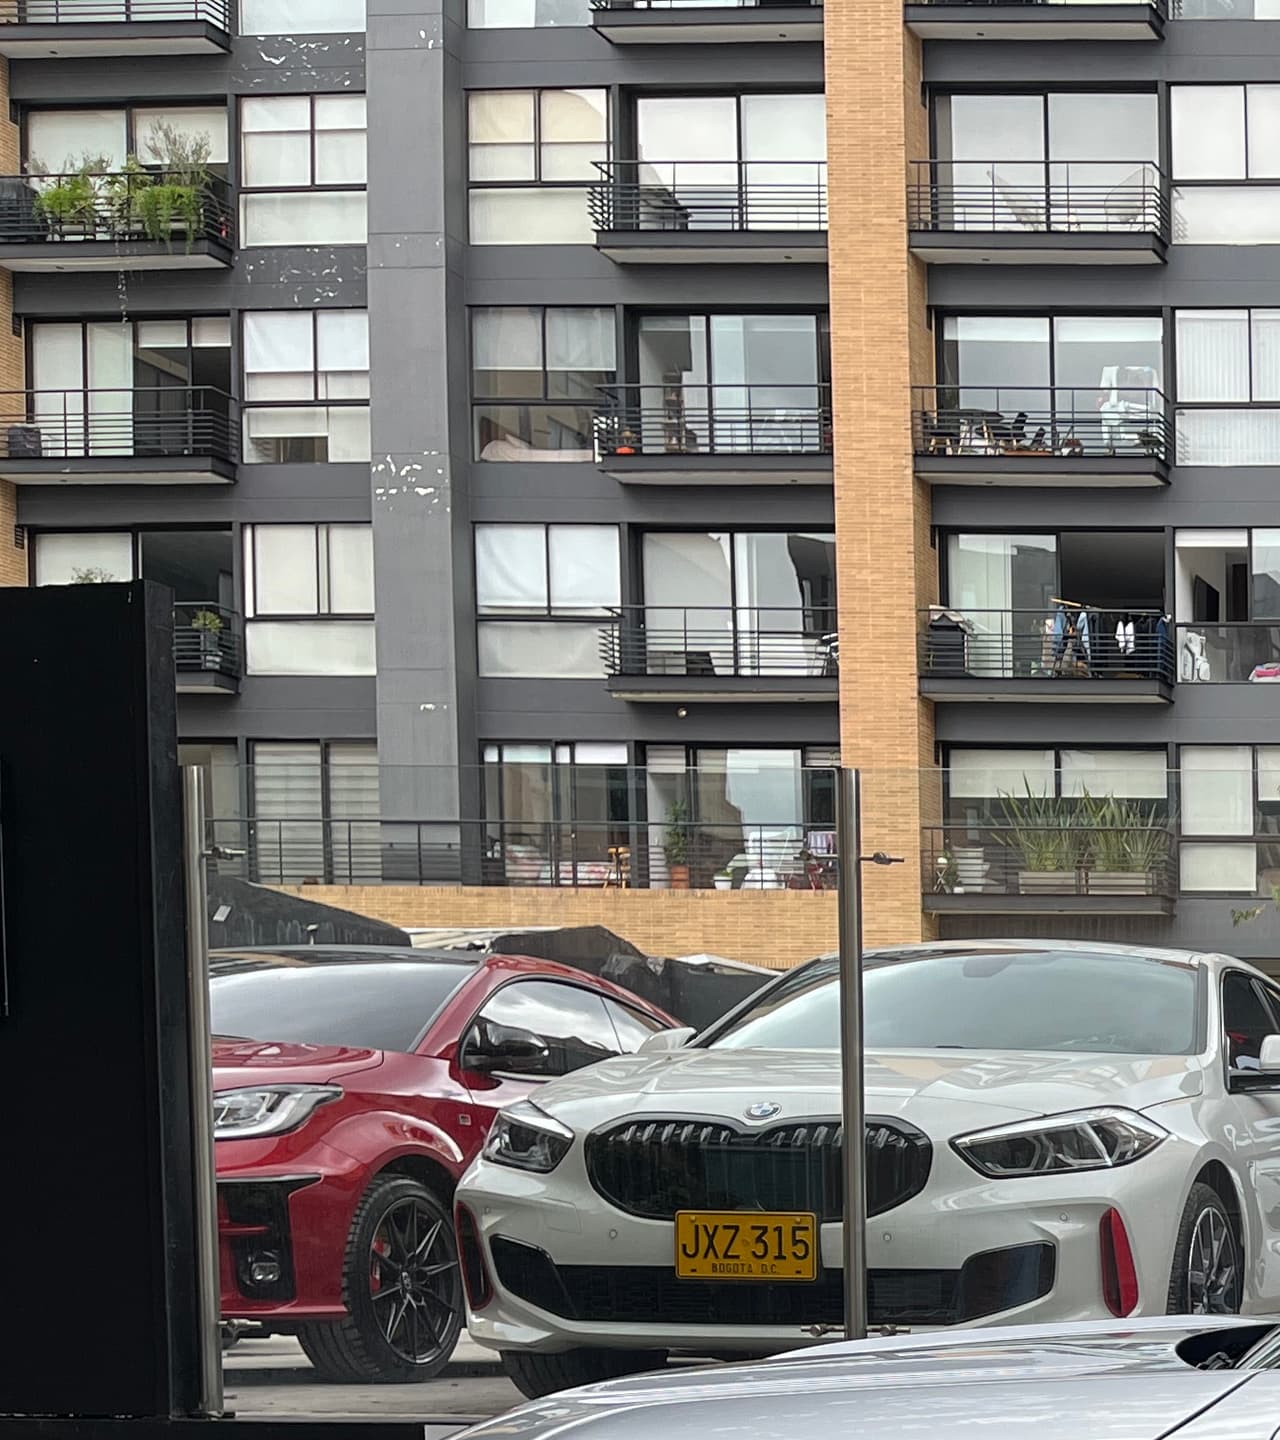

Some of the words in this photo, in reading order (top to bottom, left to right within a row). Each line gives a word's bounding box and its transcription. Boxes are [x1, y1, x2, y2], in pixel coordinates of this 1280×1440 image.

[681, 1224, 741, 1260] JXZ
[750, 1225, 810, 1261] 315
[711, 1262, 753, 1274] BOGOTA
